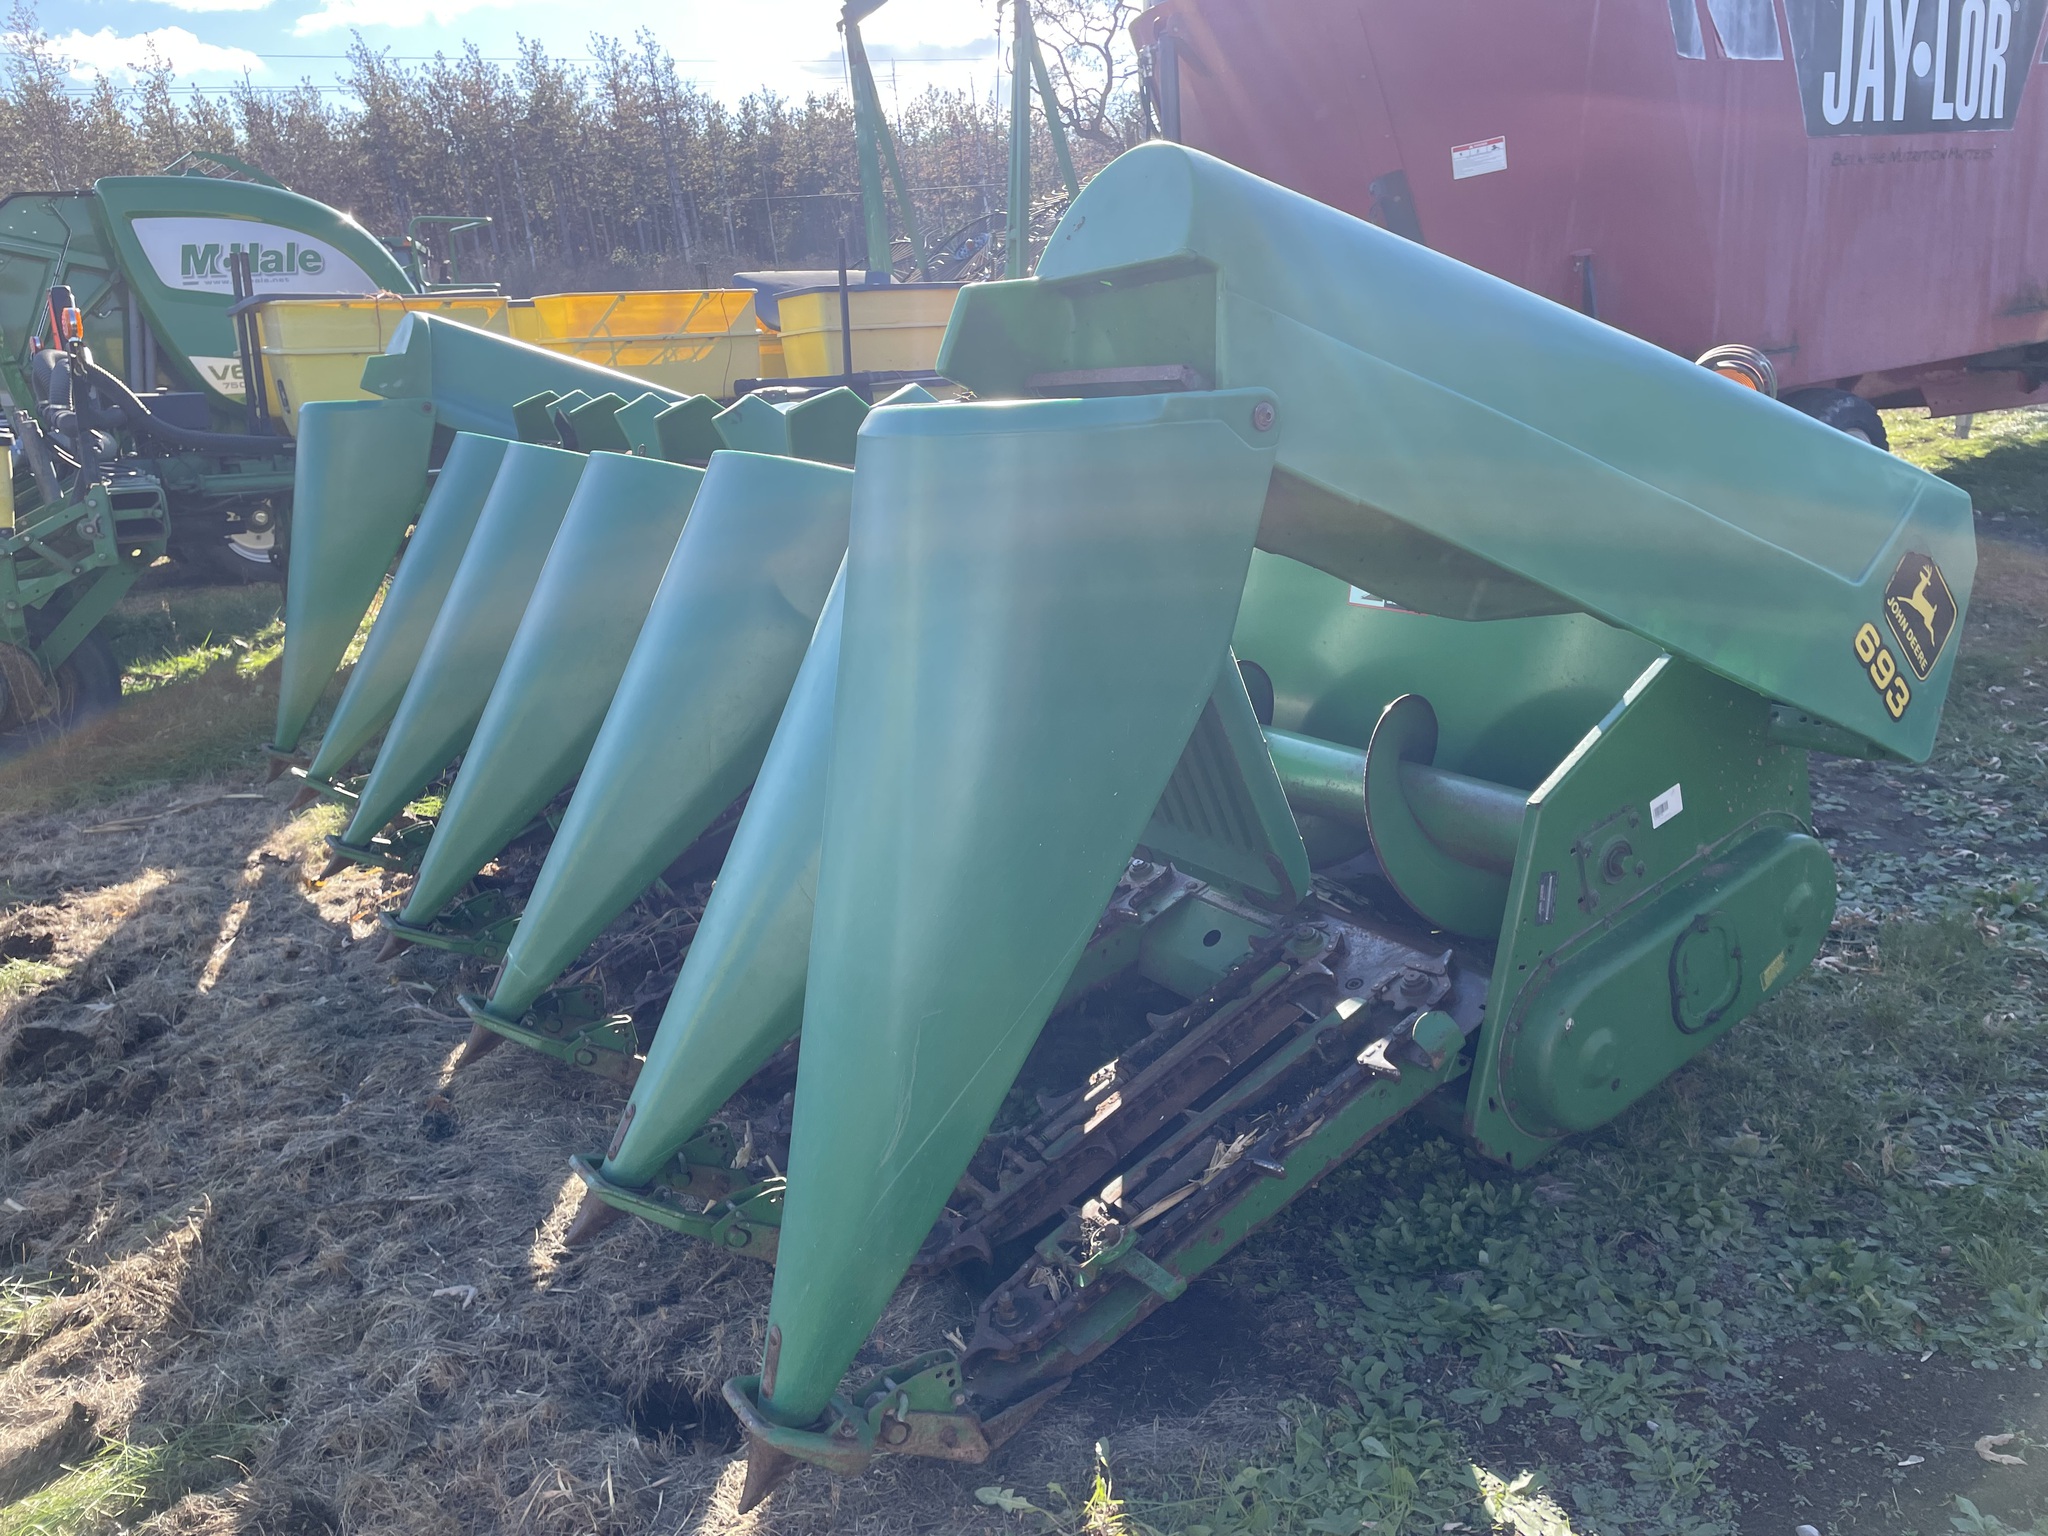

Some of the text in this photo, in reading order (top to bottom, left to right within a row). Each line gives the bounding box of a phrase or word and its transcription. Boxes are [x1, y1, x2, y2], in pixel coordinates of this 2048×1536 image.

[1854, 622, 1911, 719] 693
[1887, 597, 1928, 672] JOHN DEERE
